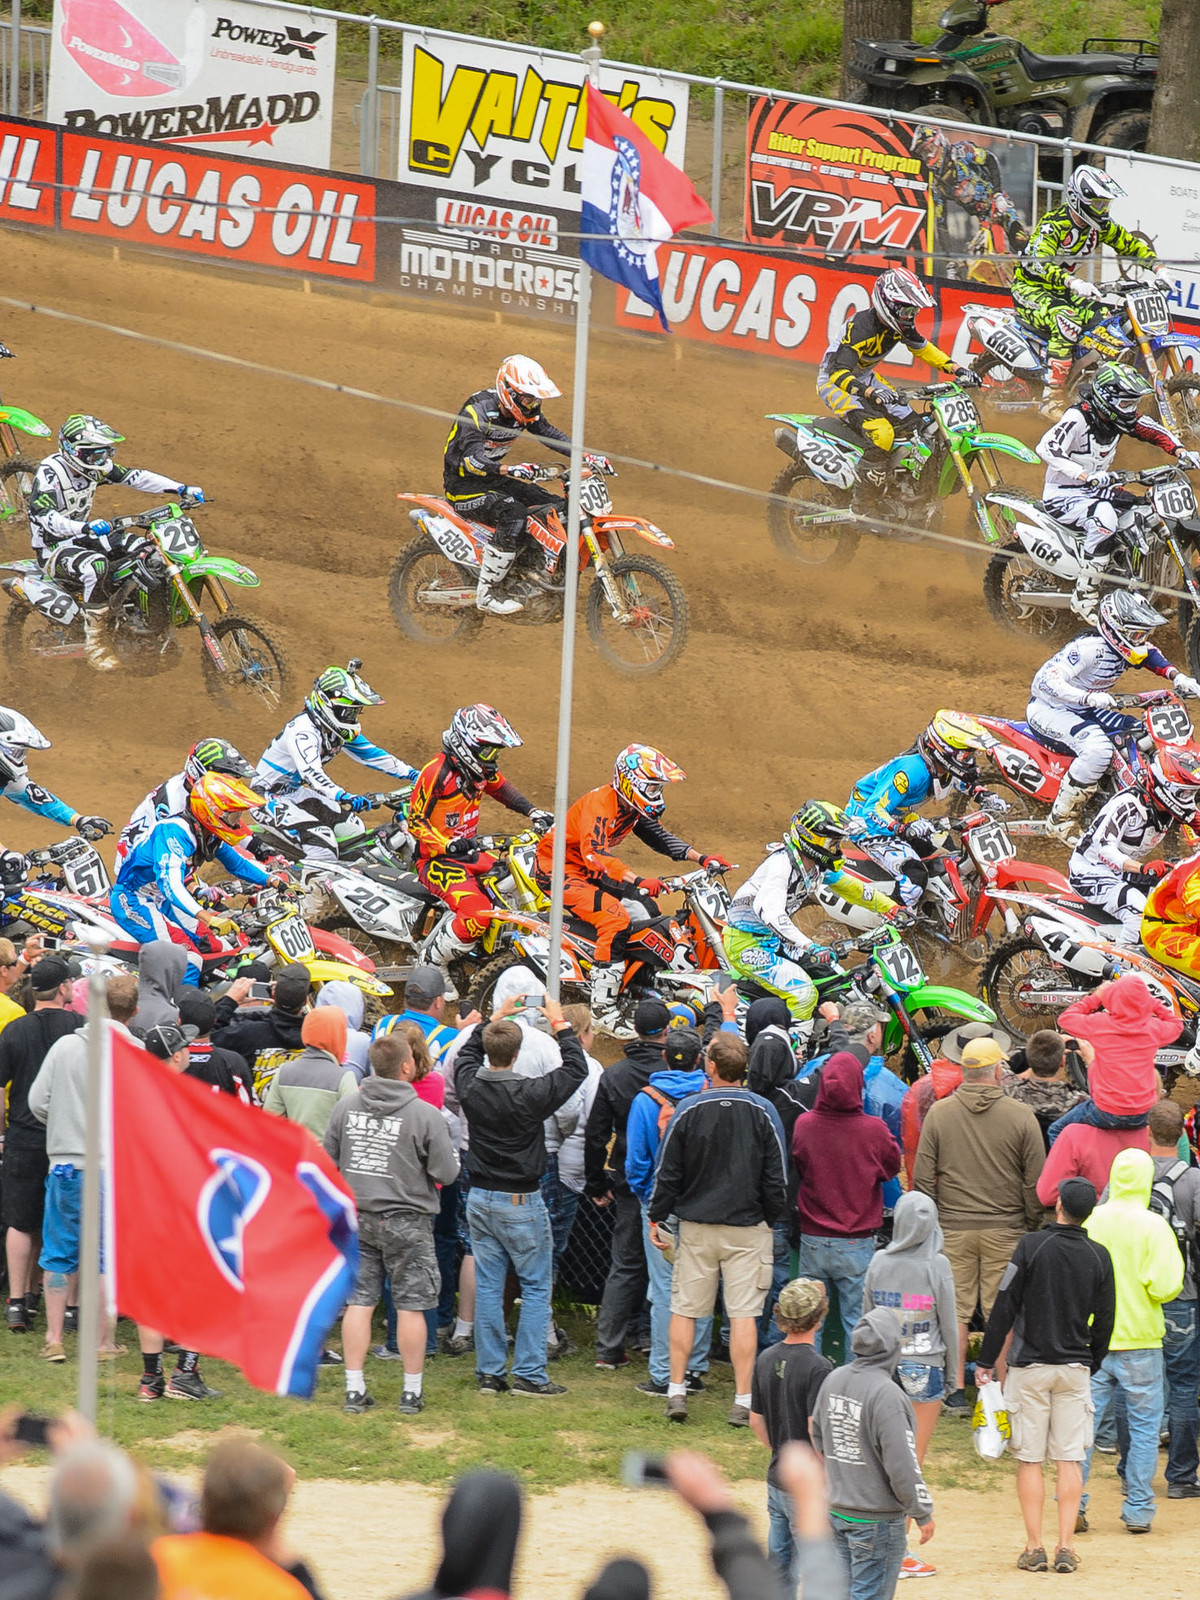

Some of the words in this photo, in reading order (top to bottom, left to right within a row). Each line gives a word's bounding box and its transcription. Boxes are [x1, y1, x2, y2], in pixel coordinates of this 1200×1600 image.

[210, 47, 264, 66] Unbreakable
[266, 54, 318, 77] Handguards
[412, 139, 584, 193] CYCL
[768, 131, 806, 155] Rider
[806, 138, 861, 164] Support
[861, 148, 921, 175] Program
[0, 135, 42, 210] IL
[70, 149, 264, 249] LUCAS
[271, 182, 363, 267] OIL
[1169, 185, 1199, 200] BOATS
[445, 202, 512, 241] LUCAS
[517, 212, 552, 246] OIL
[470, 240, 524, 260] PRO
[401, 243, 592, 303] MOTOCROSS
[400, 275, 588, 317] CHAMPIONSHI
[1133, 295, 1167, 326] 869
[986, 330, 1024, 363] 869
[1091, 325, 1127, 347] ROCK
[945, 401, 976, 428] 285
[800, 442, 844, 475] 285
[580, 481, 609, 513] 595
[1158, 488, 1194, 514] 168
[164, 521, 200, 552] 28
[437, 528, 473, 562] 595
[1030, 537, 1062, 567] 168
[35, 588, 77, 619] 28
[1152, 709, 1190, 741] 32
[1002, 753, 1043, 794] 32
[463, 808, 479, 822] RA
[978, 830, 1009, 862] 51
[73, 857, 106, 897] 57
[18, 893, 70, 922] ROCK
[345, 886, 391, 915] 20
[1057, 898, 1085, 911] HONDA
[280, 922, 312, 958] 606
[643, 929, 676, 964] BTO
[1043, 931, 1082, 963] 41
[886, 947, 920, 982] 12
[912, 1041, 932, 1074] DUNLO
[345, 1113, 402, 1136] M&M
